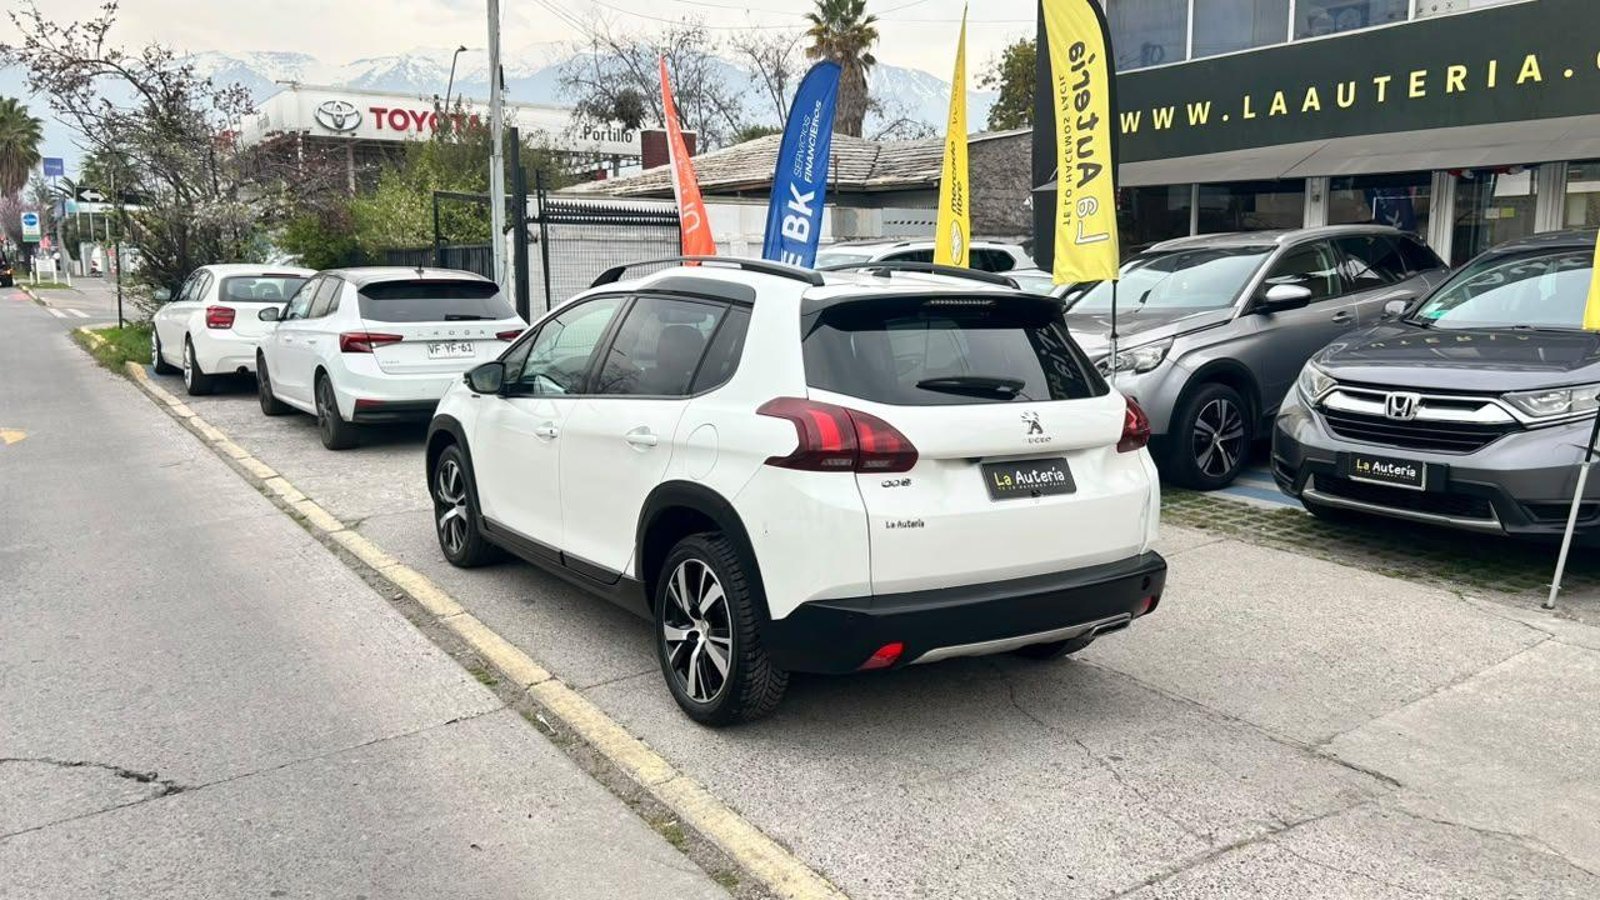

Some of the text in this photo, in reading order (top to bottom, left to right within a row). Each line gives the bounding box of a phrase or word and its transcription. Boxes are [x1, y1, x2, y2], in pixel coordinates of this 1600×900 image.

[1119, 50, 1600, 134] WWW.LAAUTERIA.
[793, 114, 812, 177] SERVICIOS
[804, 100, 822, 184] FINANCIEROS
[781, 181, 815, 243] BK
[994, 472, 1012, 486] La
[1356, 459, 1370, 470] La
[1372, 461, 1416, 477] Autería
[885, 521, 895, 529] La
